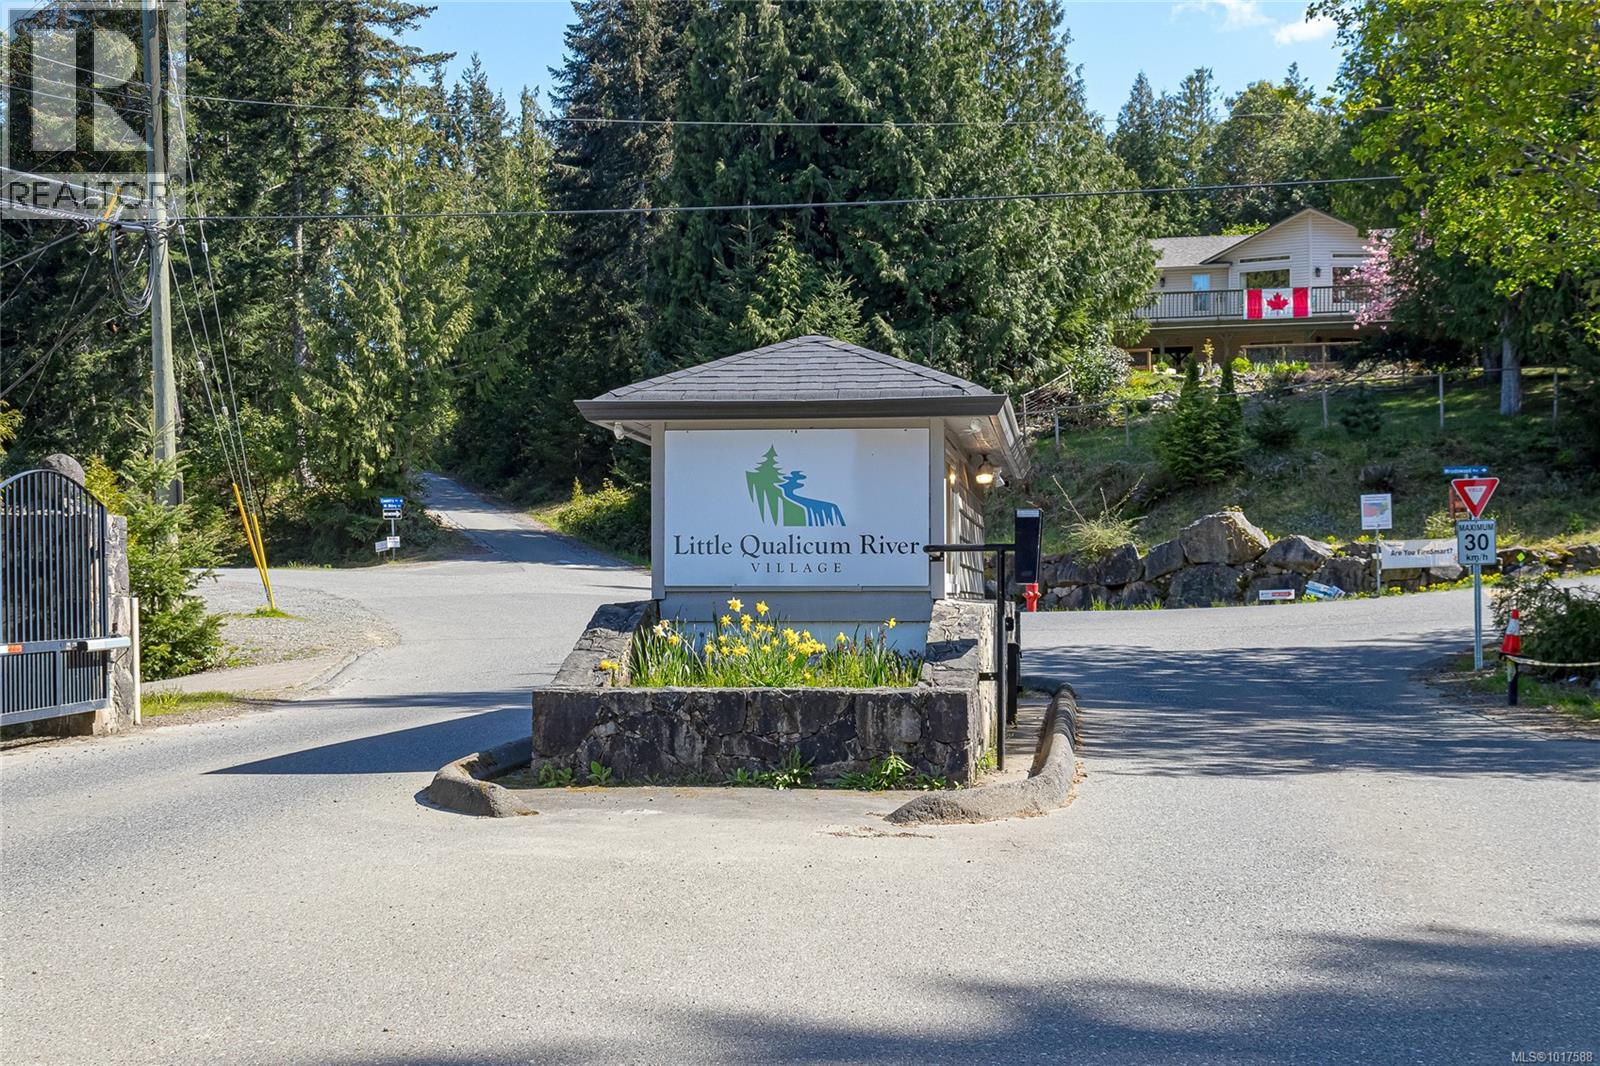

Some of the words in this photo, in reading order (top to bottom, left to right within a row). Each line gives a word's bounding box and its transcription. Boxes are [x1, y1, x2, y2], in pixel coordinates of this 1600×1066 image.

[673, 534, 732, 555] Little
[740, 534, 852, 558] Qualicum
[859, 534, 920, 555] River
[1464, 533, 1489, 551] 30
[751, 562, 842, 573] VILLAGE
